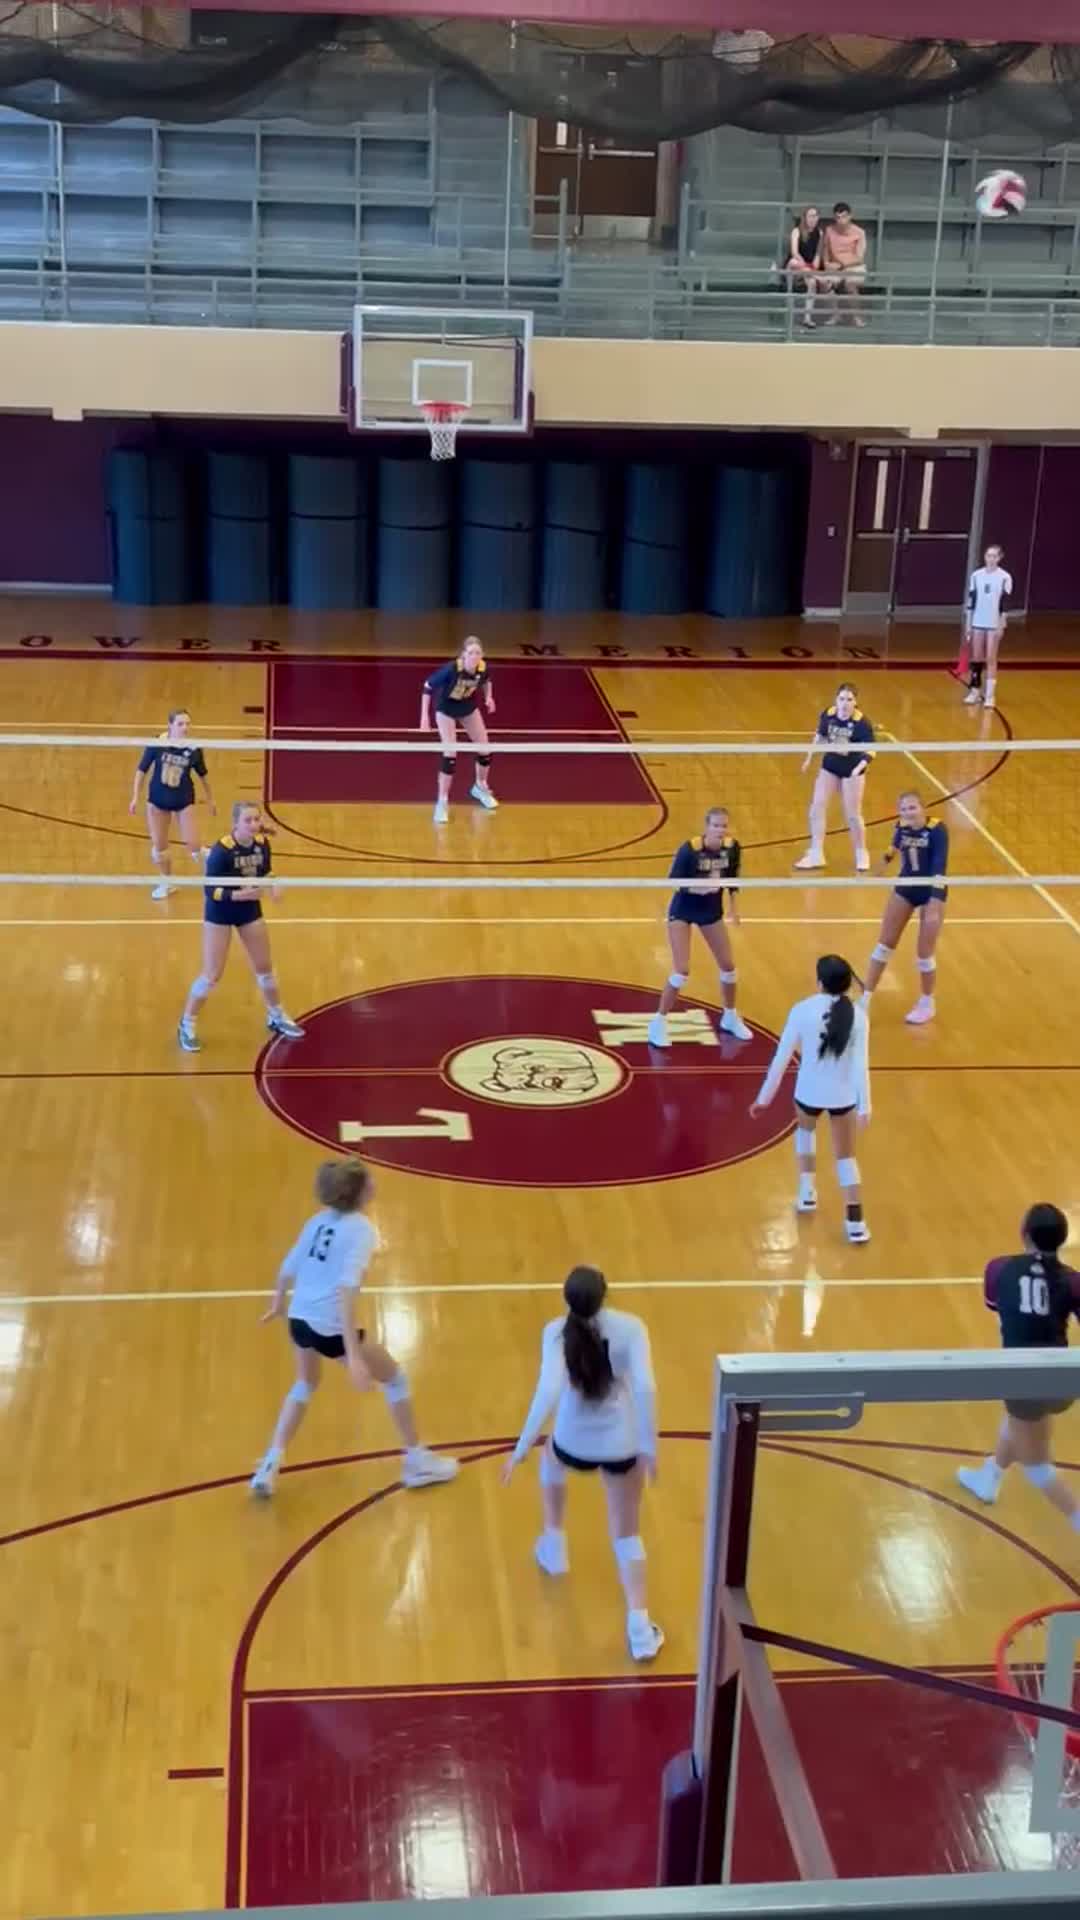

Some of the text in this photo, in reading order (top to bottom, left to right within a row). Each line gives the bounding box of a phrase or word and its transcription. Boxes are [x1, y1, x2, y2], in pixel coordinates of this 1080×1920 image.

[519, 644, 881, 659] MERION
[308, 1223, 335, 1262] 13
[1018, 1274, 1050, 1316] 10
